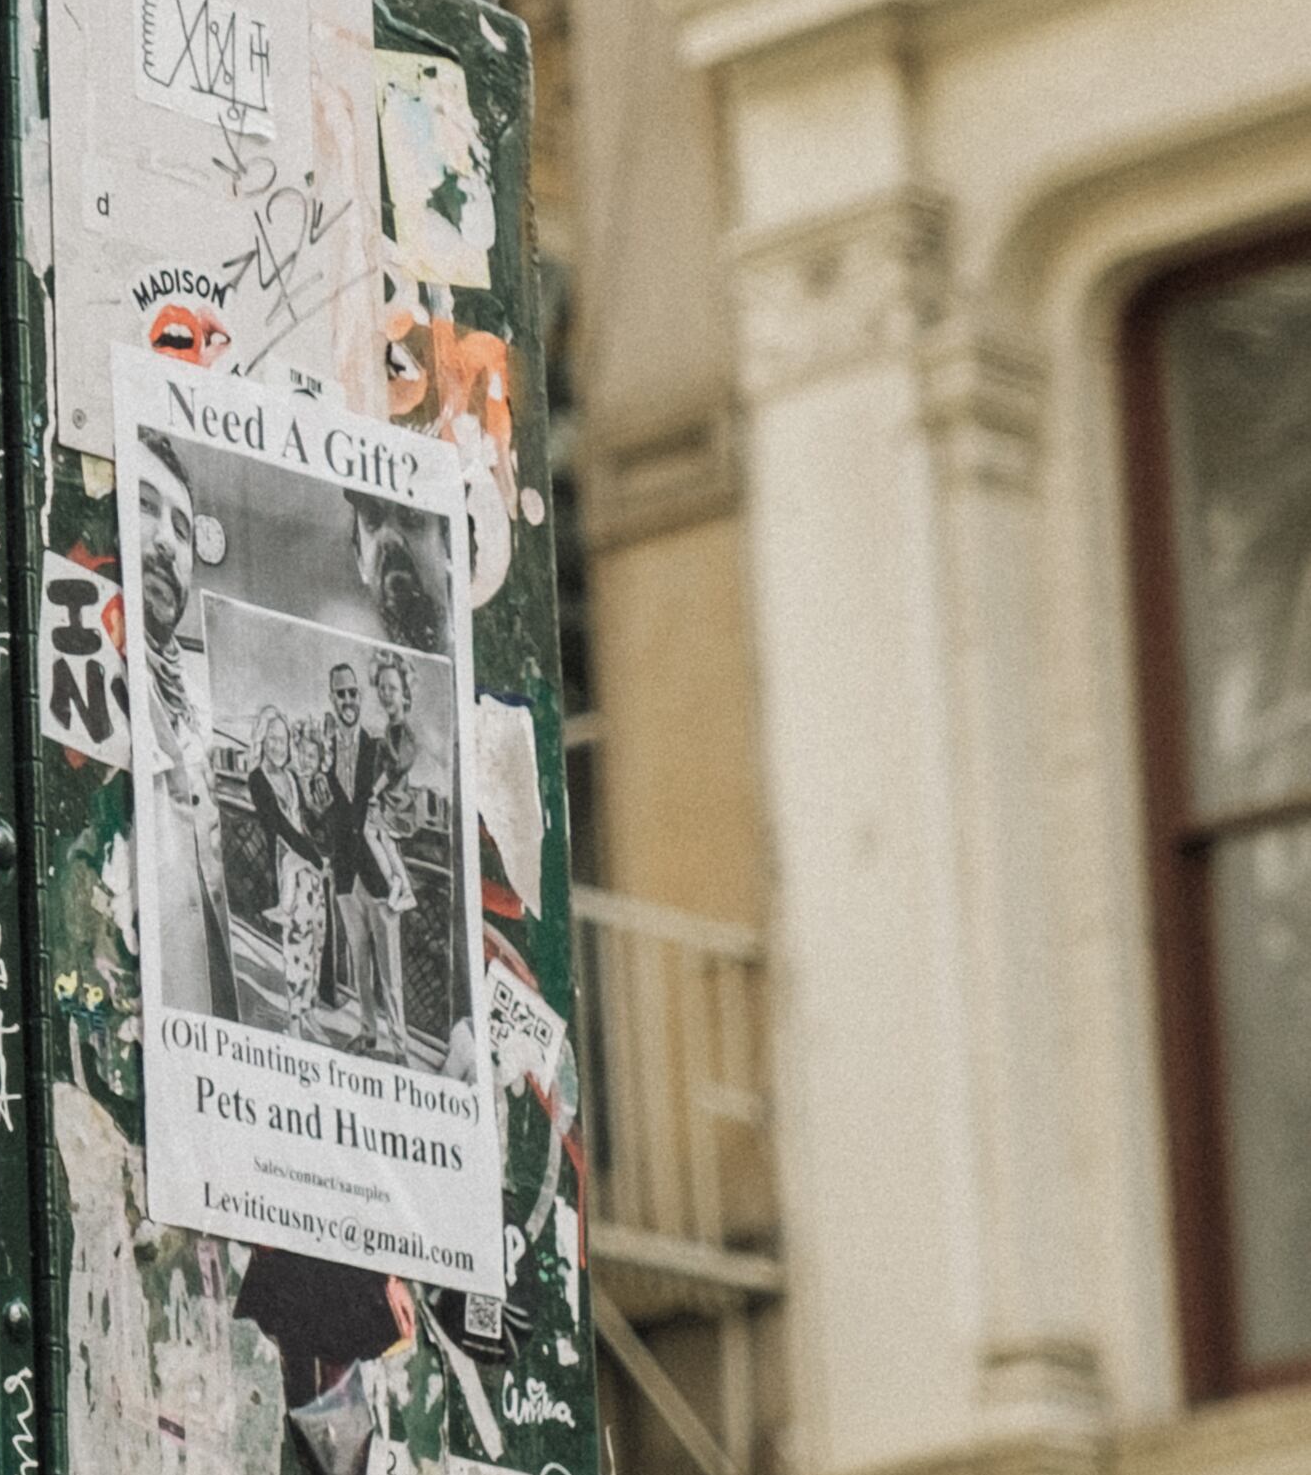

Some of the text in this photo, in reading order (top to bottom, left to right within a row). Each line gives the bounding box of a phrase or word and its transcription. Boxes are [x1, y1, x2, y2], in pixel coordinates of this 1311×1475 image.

[132, 268, 229, 311] MADISON
[166, 380, 419, 499] Need A Gift?
[161, 1017, 481, 1126] (Oil Paintings from Photos)
[194, 1074, 464, 1173] Pets and Humans
[203, 1181, 475, 1274] Leviticusnyc@gmail.com
[252, 1155, 391, 1205] Sales/contact/samples
